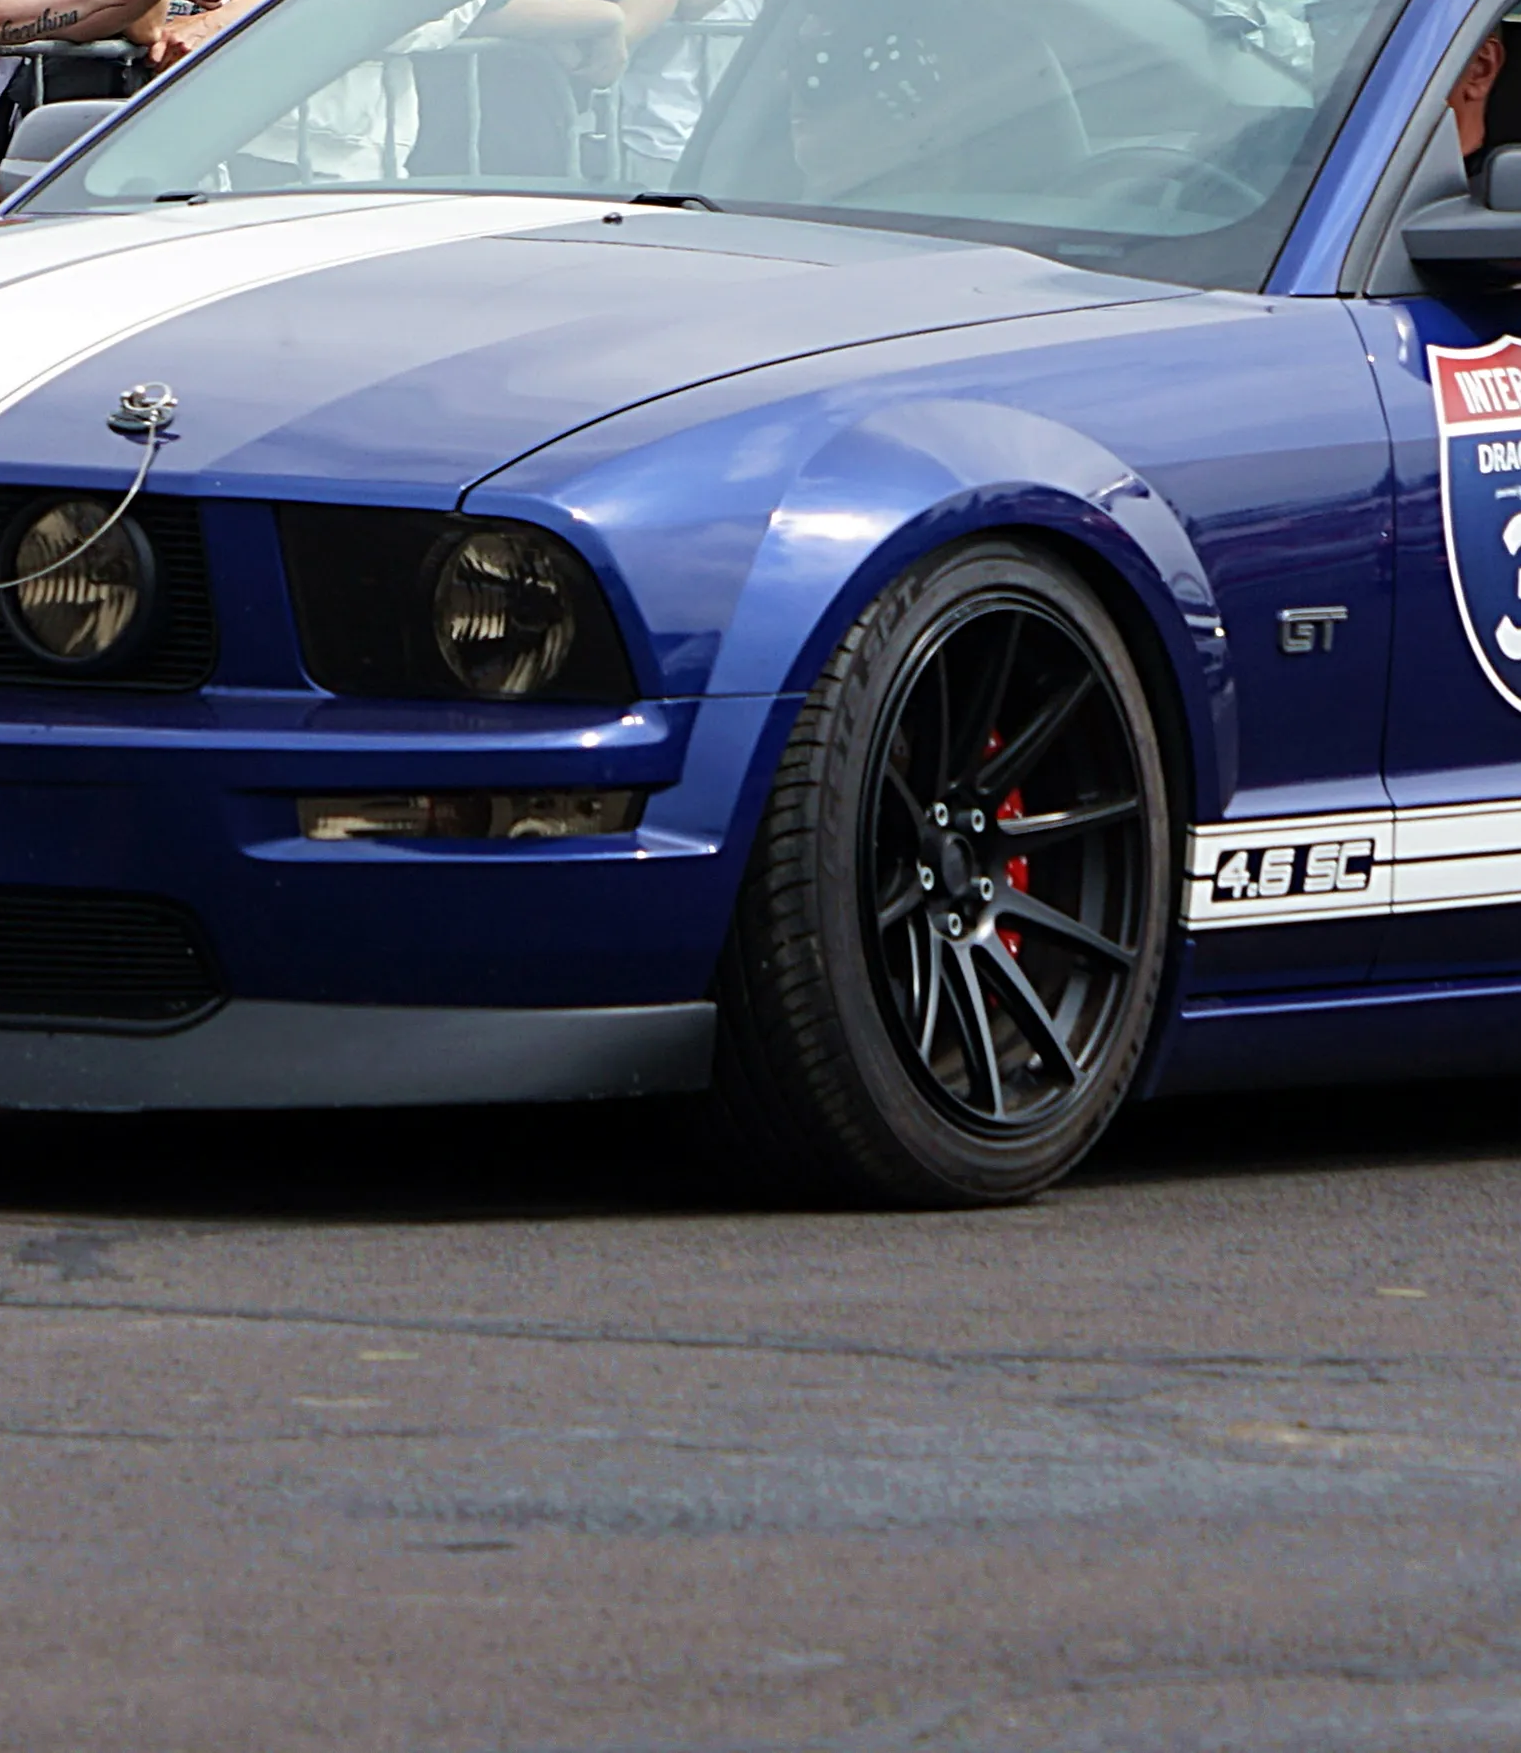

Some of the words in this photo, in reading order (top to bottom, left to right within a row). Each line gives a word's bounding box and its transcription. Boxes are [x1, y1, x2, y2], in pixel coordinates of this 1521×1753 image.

[1278, 606, 1348, 653] GT
[1216, 847, 1295, 898] 4.6
[1303, 841, 1373, 892] SC
